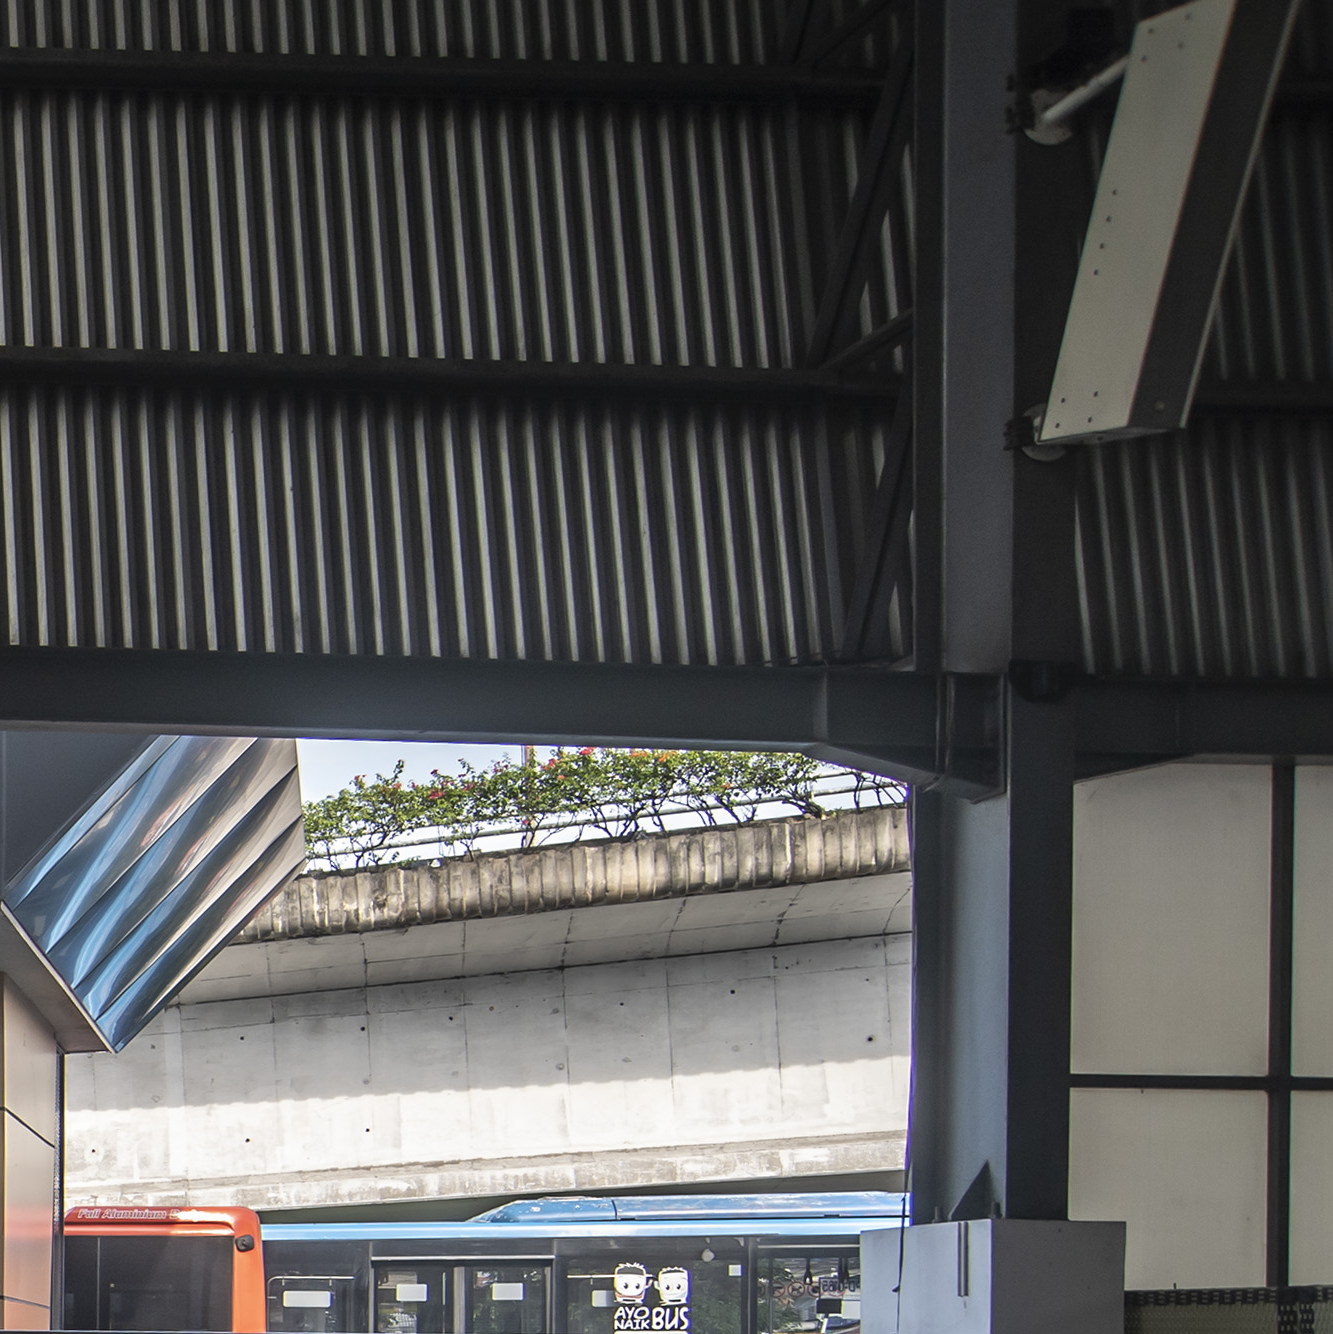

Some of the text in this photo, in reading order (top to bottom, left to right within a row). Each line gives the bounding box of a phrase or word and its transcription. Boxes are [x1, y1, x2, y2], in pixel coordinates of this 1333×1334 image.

[614, 1306, 650, 1319] AYO
[652, 1306, 690, 1330] BUS
[614, 1319, 650, 1330] NAIK
